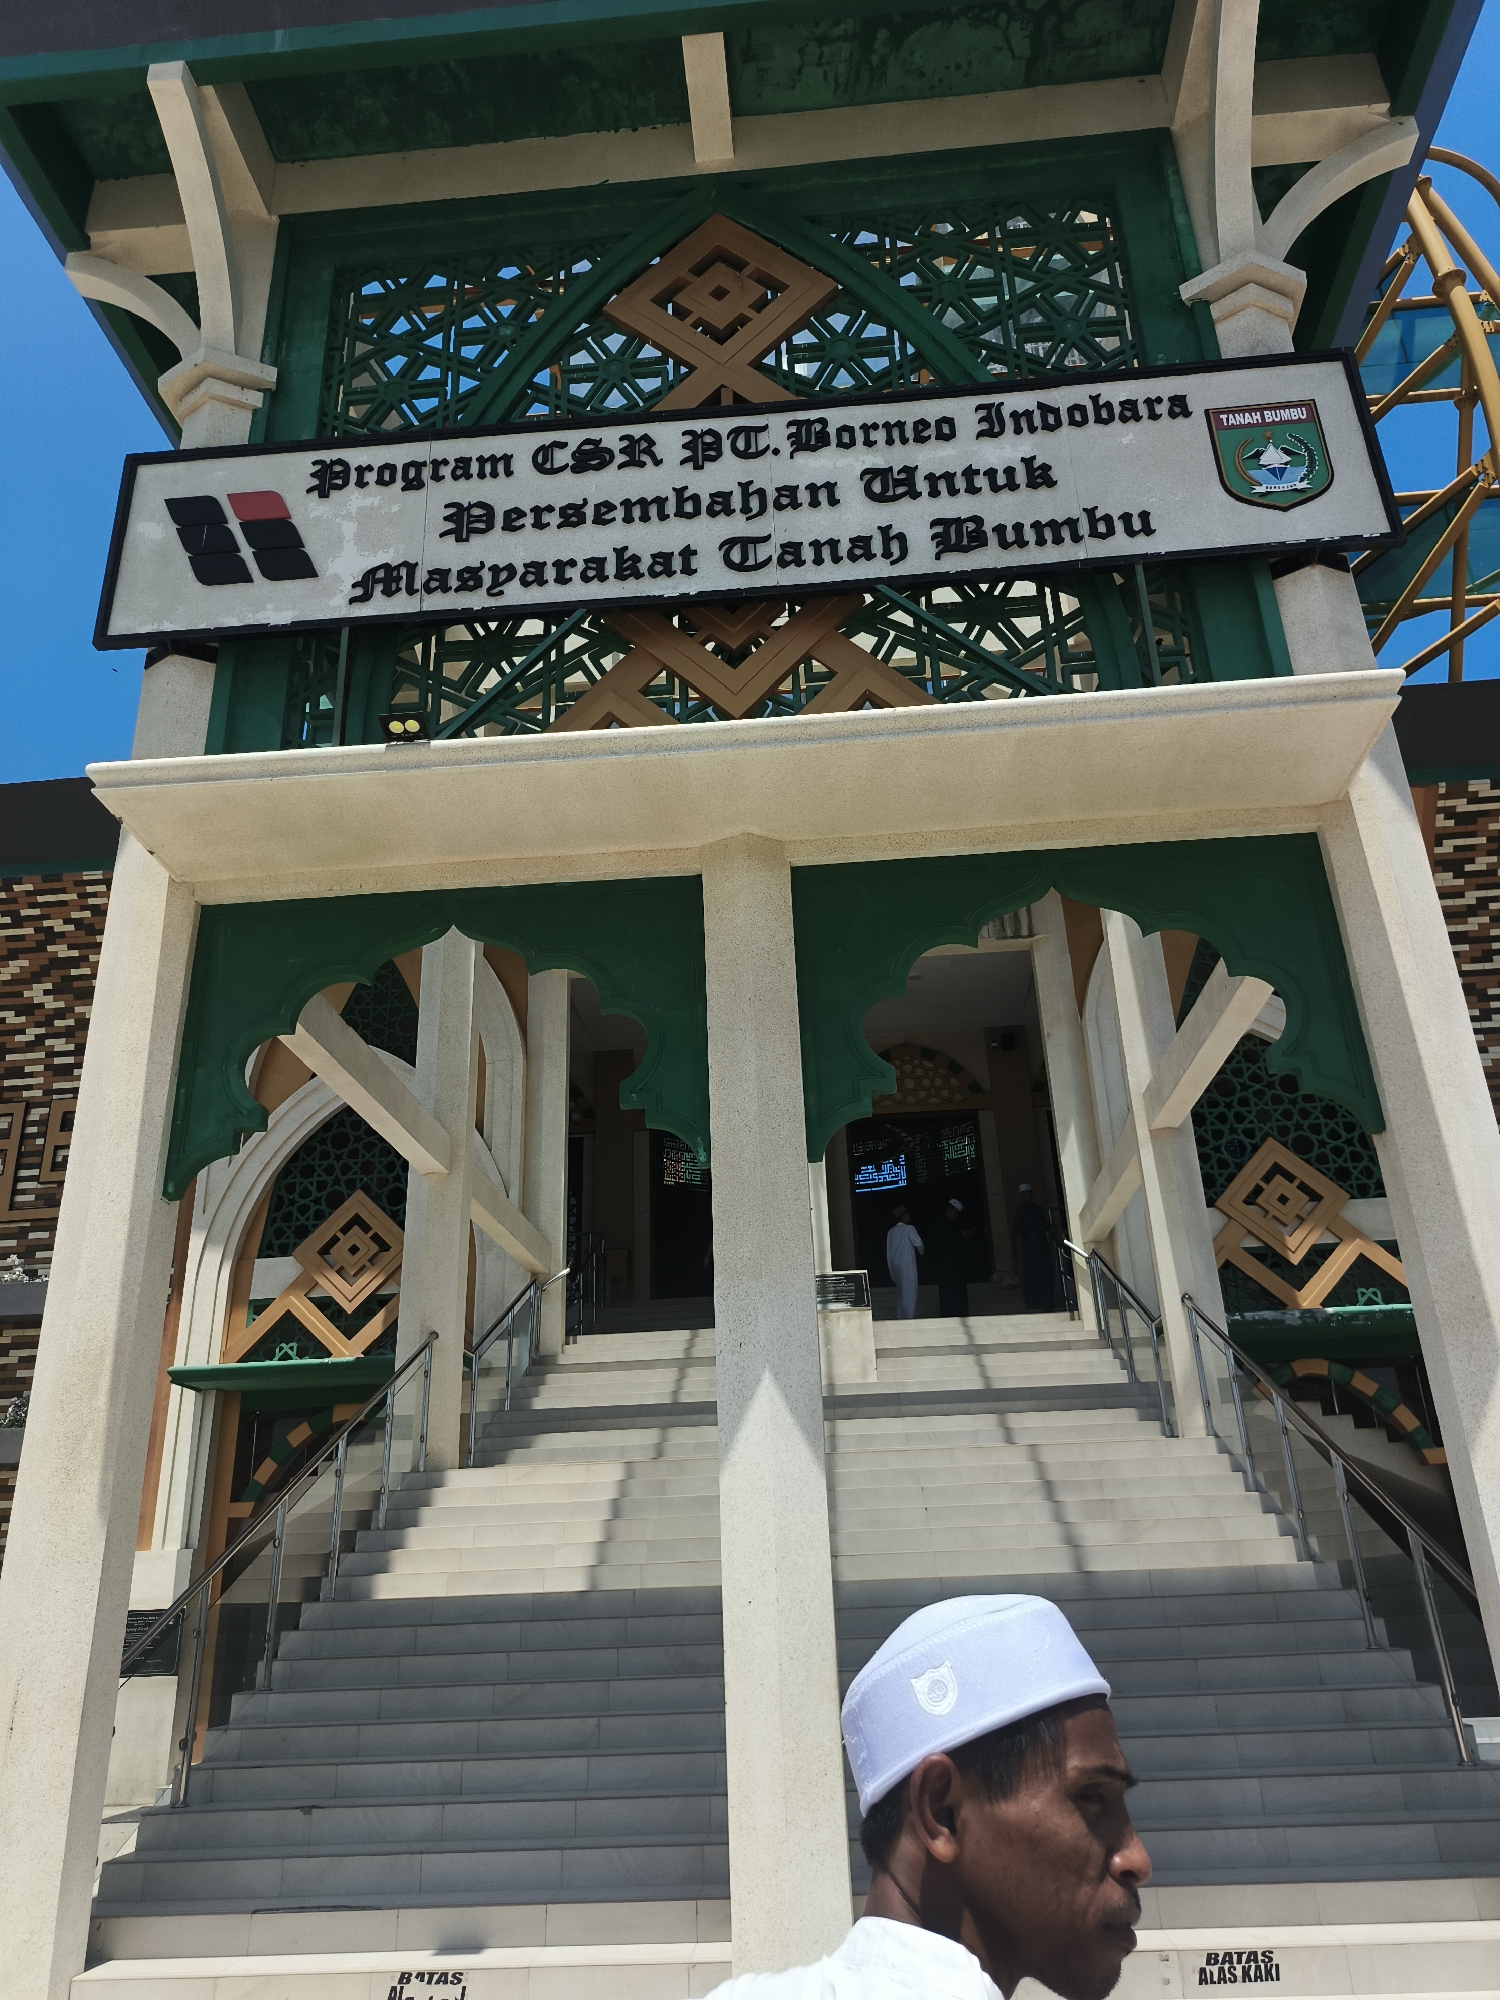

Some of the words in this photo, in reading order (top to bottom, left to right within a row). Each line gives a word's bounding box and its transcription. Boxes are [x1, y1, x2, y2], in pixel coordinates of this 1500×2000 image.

[306, 452, 515, 498] Program
[531, 432, 664, 476] CSR
[974, 391, 1193, 441] Indobara
[1220, 411, 1262, 426] TANAH
[1263, 407, 1307, 422] BUMBU
[438, 480, 841, 544] Persembahan
[859, 454, 1058, 504] Untuk
[348, 543, 698, 606] Masyarakat
[717, 523, 909, 573] Tanah
[929, 505, 1157, 562] Bumbu
[1198, 1965, 1238, 1986] ALAS
[1241, 1963, 1281, 1984] KAKI
[1205, 1950, 1274, 1967] BATAS
